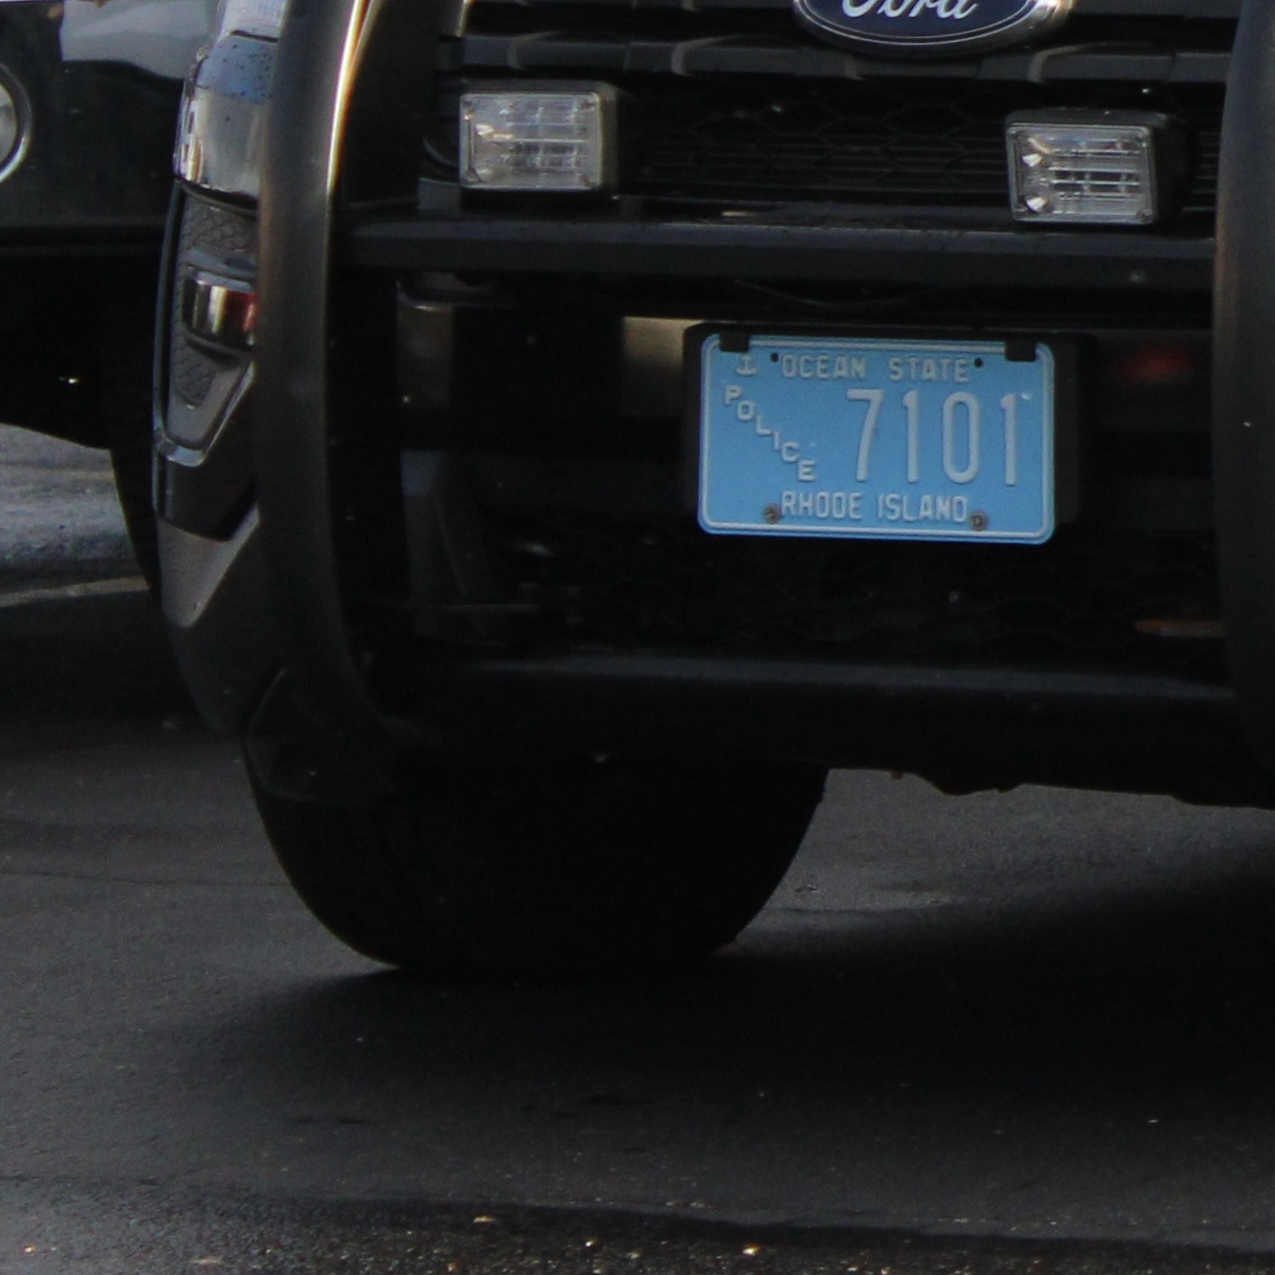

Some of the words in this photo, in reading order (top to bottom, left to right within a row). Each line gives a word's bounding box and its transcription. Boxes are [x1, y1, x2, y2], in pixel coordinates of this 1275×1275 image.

[781, 353, 867, 380] OCEAN
[888, 357, 970, 384] STATE
[724, 383, 818, 482] POLICE
[847, 388, 1019, 486] 7101
[781, 491, 863, 521] RHODE
[877, 493, 969, 524] ISLAND
